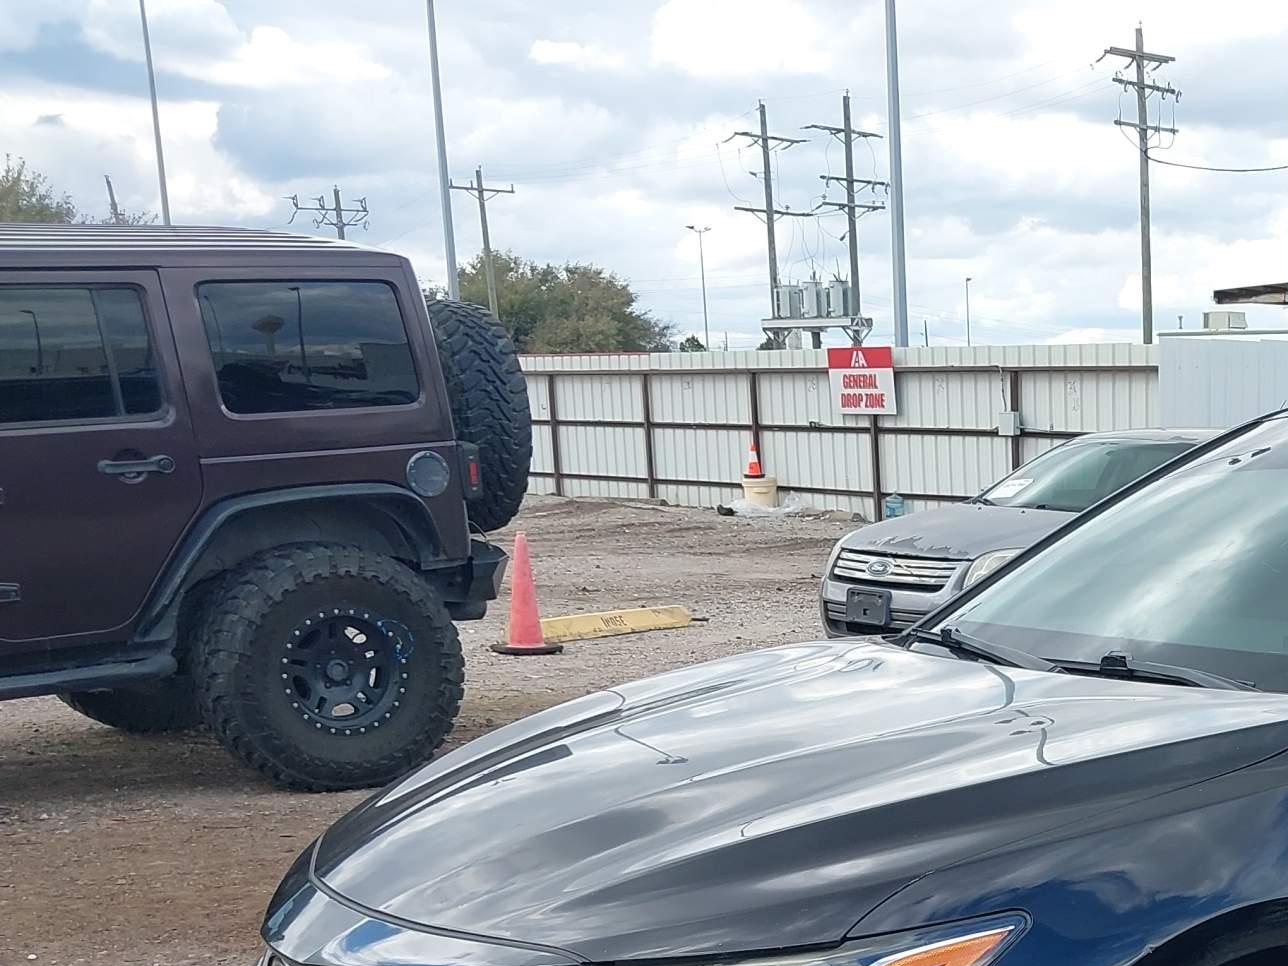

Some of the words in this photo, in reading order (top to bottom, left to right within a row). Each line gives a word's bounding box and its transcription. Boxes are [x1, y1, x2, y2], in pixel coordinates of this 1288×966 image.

[843, 374, 878, 389] GENERAL
[841, 393, 863, 408] DROP
[864, 393, 885, 408] ZONE
